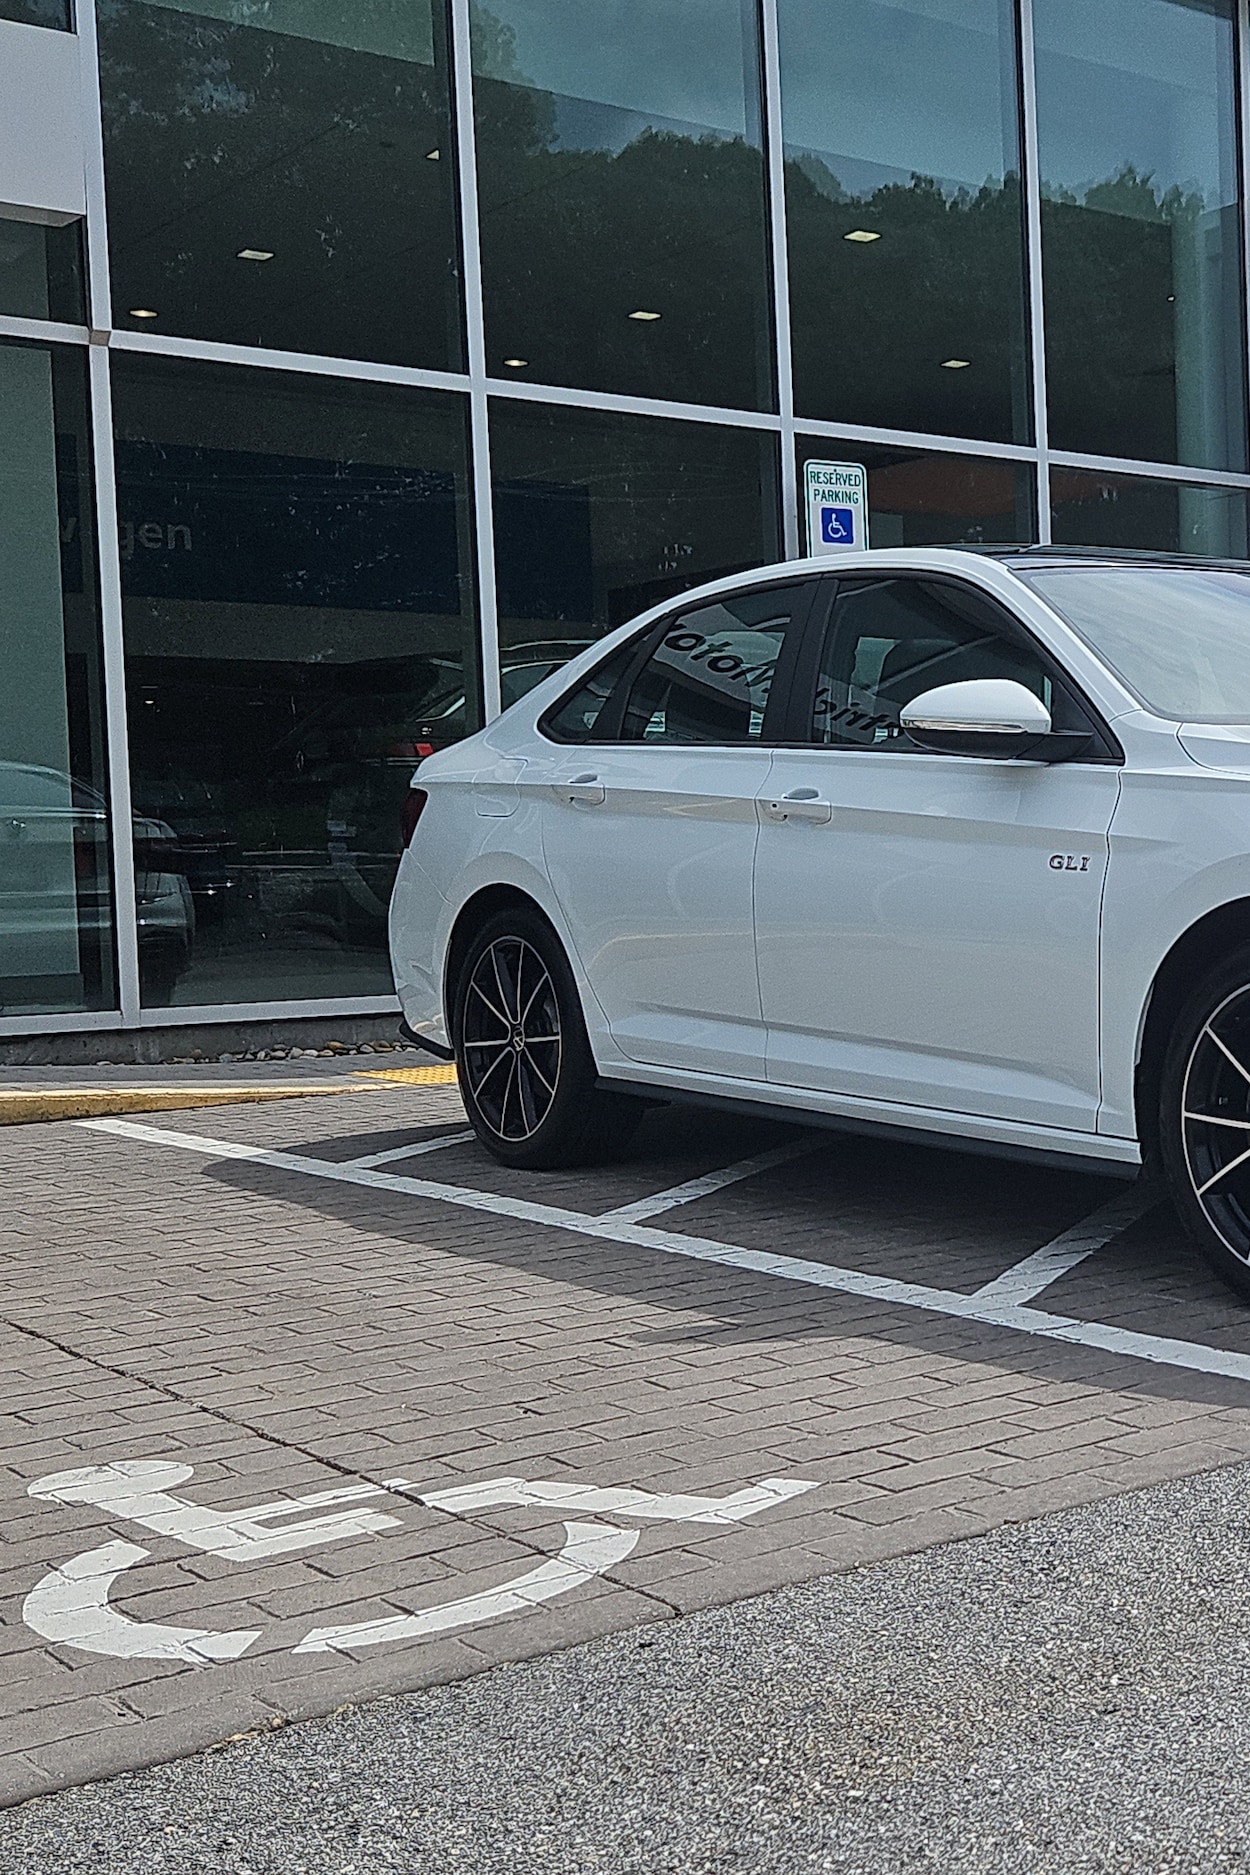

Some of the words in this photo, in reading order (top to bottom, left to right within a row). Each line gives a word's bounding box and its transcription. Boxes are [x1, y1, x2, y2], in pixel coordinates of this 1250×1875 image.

[810, 470, 861, 487] RESERVED
[814, 488, 859, 505] PARKING
[1049, 854, 1091, 871] GLI
